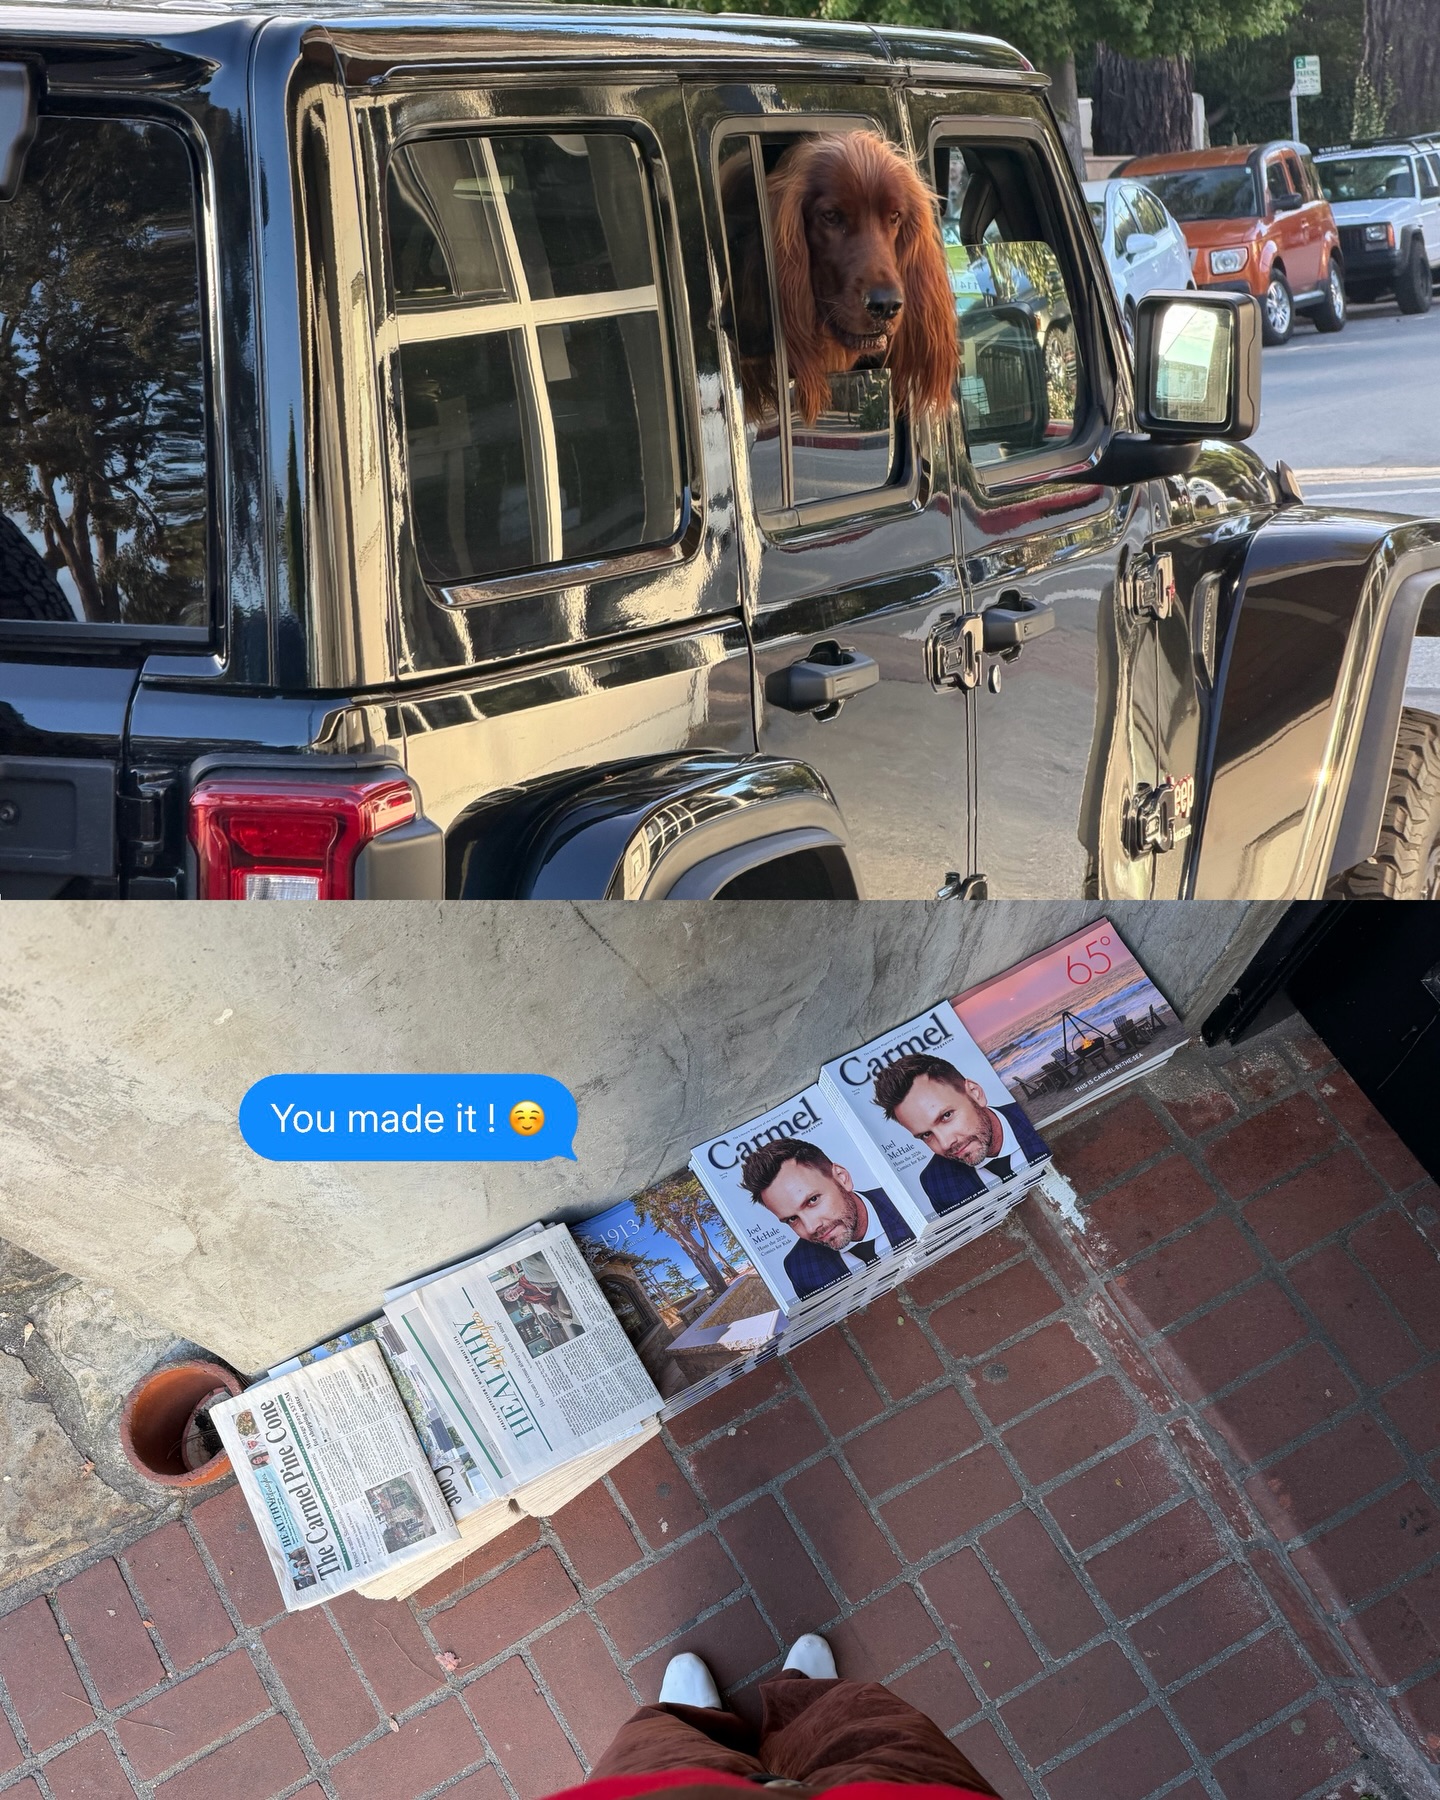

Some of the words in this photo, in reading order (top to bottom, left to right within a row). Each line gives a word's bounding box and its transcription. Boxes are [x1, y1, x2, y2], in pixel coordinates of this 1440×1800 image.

[1164, 773, 1195, 818] eep
[839, 1012, 952, 1084] Carmel
[931, 1036, 955, 1051] magazine
[1073, 1082, 1088, 1092] THIS
[708, 1096, 821, 1169] Carmel
[800, 1121, 824, 1136] magazine
[881, 1139, 896, 1153] Joel
[887, 1141, 915, 1160] McHale
[598, 1219, 640, 1248] 1913
[745, 1223, 762, 1237] Joel
[751, 1225, 780, 1245] McHale
[493, 1318, 506, 1334] steep?
[470, 1310, 507, 1369] Lifestyles
[501, 1332, 509, 1343] this
[505, 1341, 515, 1353] been
[512, 1351, 524, 1368] always
[451, 1315, 536, 1440] HEALTHY
[520, 1367, 532, 1384] Avenue
[529, 1383, 540, 1398] Ocean
[283, 1391, 296, 1412] $37.5M
[294, 1395, 304, 1412] center
[536, 1397, 545, 1407] Has
[258, 1398, 288, 1445] Cone
[293, 1412, 302, 1425] pays
[300, 1412, 316, 1438] shopping
[298, 1425, 312, 1449] Montage
[311, 1437, 319, 1446] for
[277, 1443, 305, 1484] Pine
[309, 1452, 321, 1471] historic
[423, 1464, 432, 1476] with
[317, 1470, 330, 1491] declared
[428, 1475, 441, 1497] Hacienda
[433, 1464, 462, 1507] Cone
[326, 1490, 338, 1508] Terrace
[437, 1497, 447, 1510] slaps
[287, 1481, 330, 1546] Carmel
[333, 1508, 349, 1536] Stonehouse
[443, 1510, 454, 1527] County
[267, 1499, 292, 1548] HEALTHY
[345, 1536, 354, 1550] wants
[315, 1543, 342, 1581] The
[349, 1550, 361, 1567] Owner
